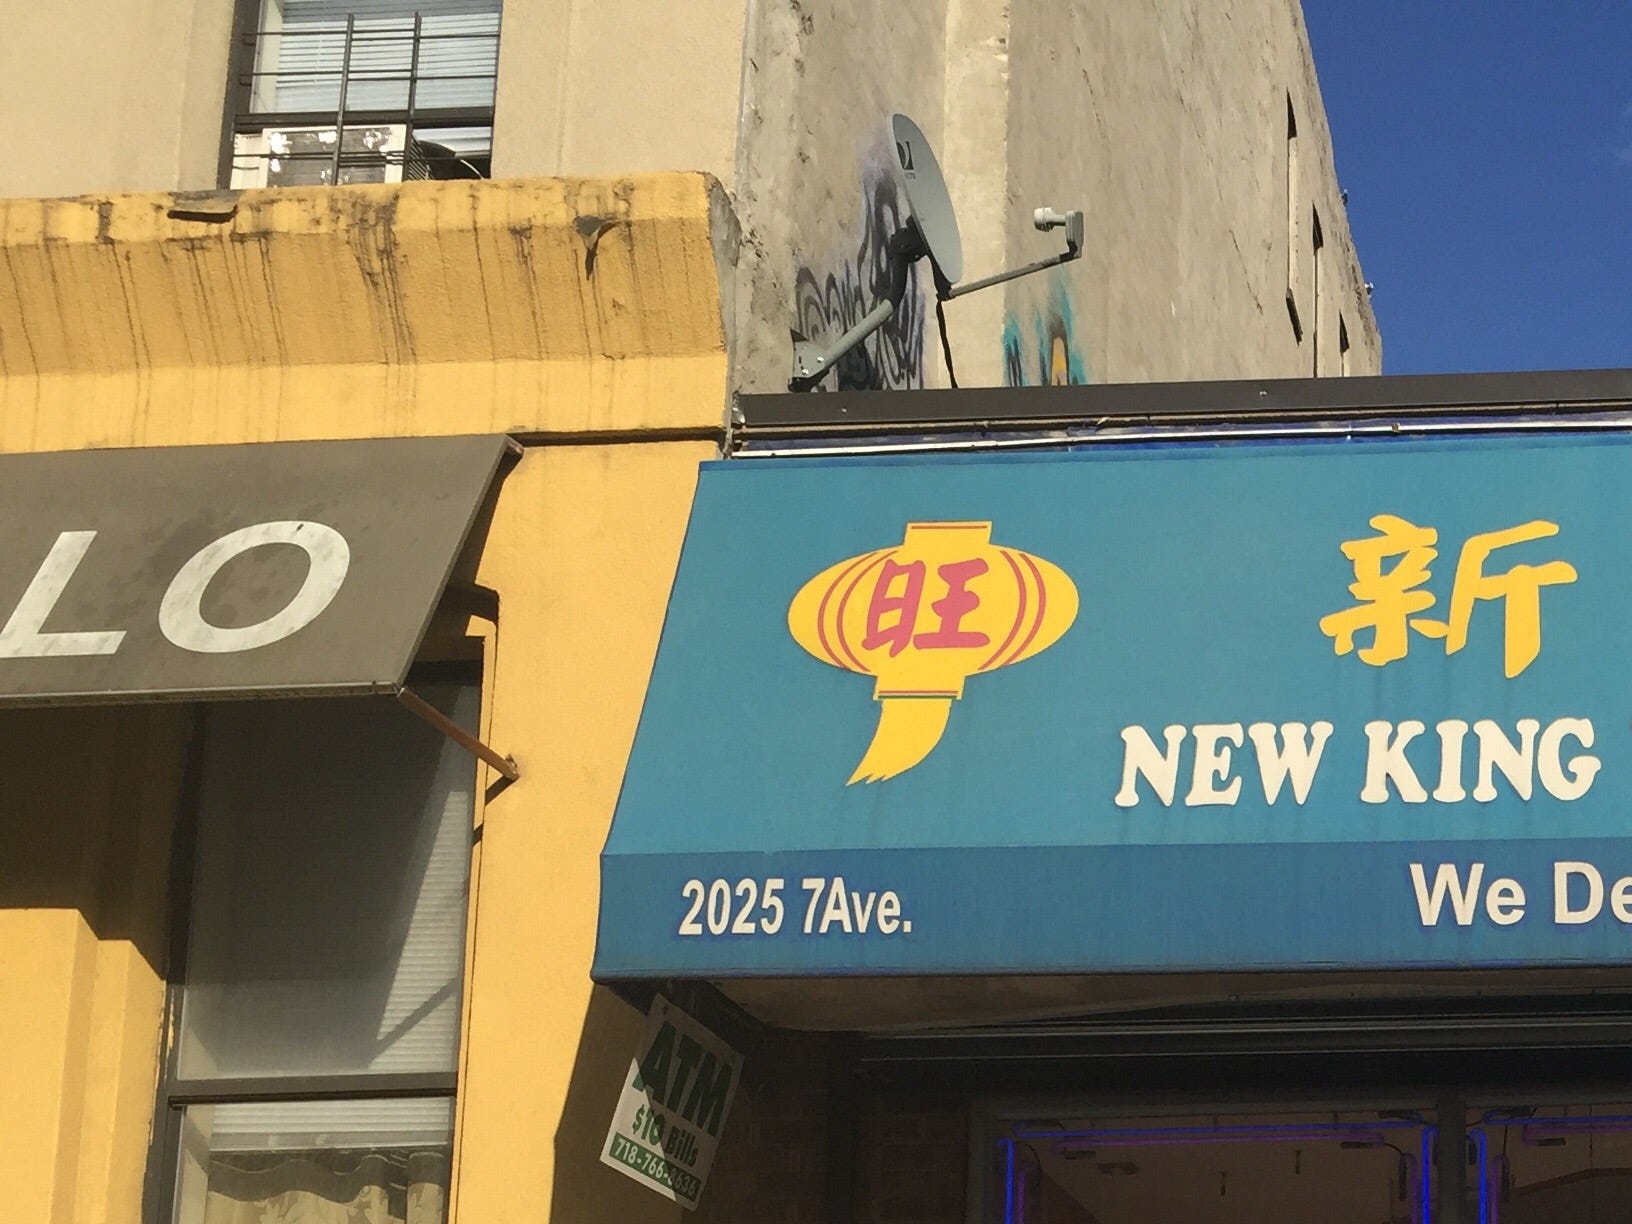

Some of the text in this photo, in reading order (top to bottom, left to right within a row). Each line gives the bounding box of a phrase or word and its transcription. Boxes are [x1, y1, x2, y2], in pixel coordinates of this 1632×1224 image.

[861, 558, 990, 657] 旺
[1115, 721, 1333, 807] NEW
[1360, 717, 1601, 804] KING
[678, 876, 912, 935] 2025 7Ave.
[1409, 863, 1526, 926] We
[632, 1021, 733, 1137] ATM
[632, 1104, 698, 1168] $10 Bills
